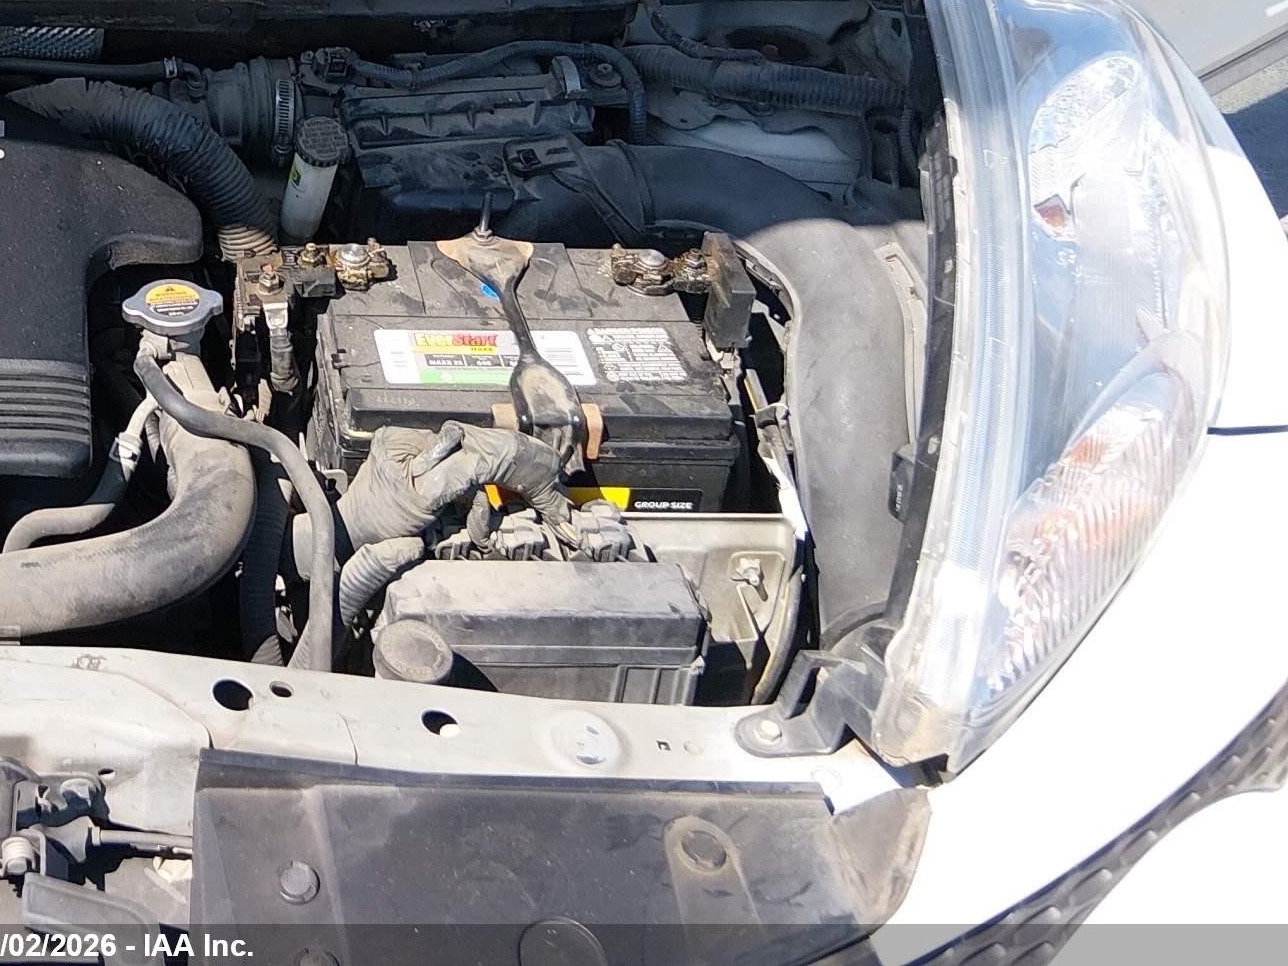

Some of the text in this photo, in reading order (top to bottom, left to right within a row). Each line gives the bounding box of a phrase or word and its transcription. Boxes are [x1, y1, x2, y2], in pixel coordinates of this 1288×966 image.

[414, 332, 499, 347] EverStart
[634, 501, 694, 510] GROUP SIZE
